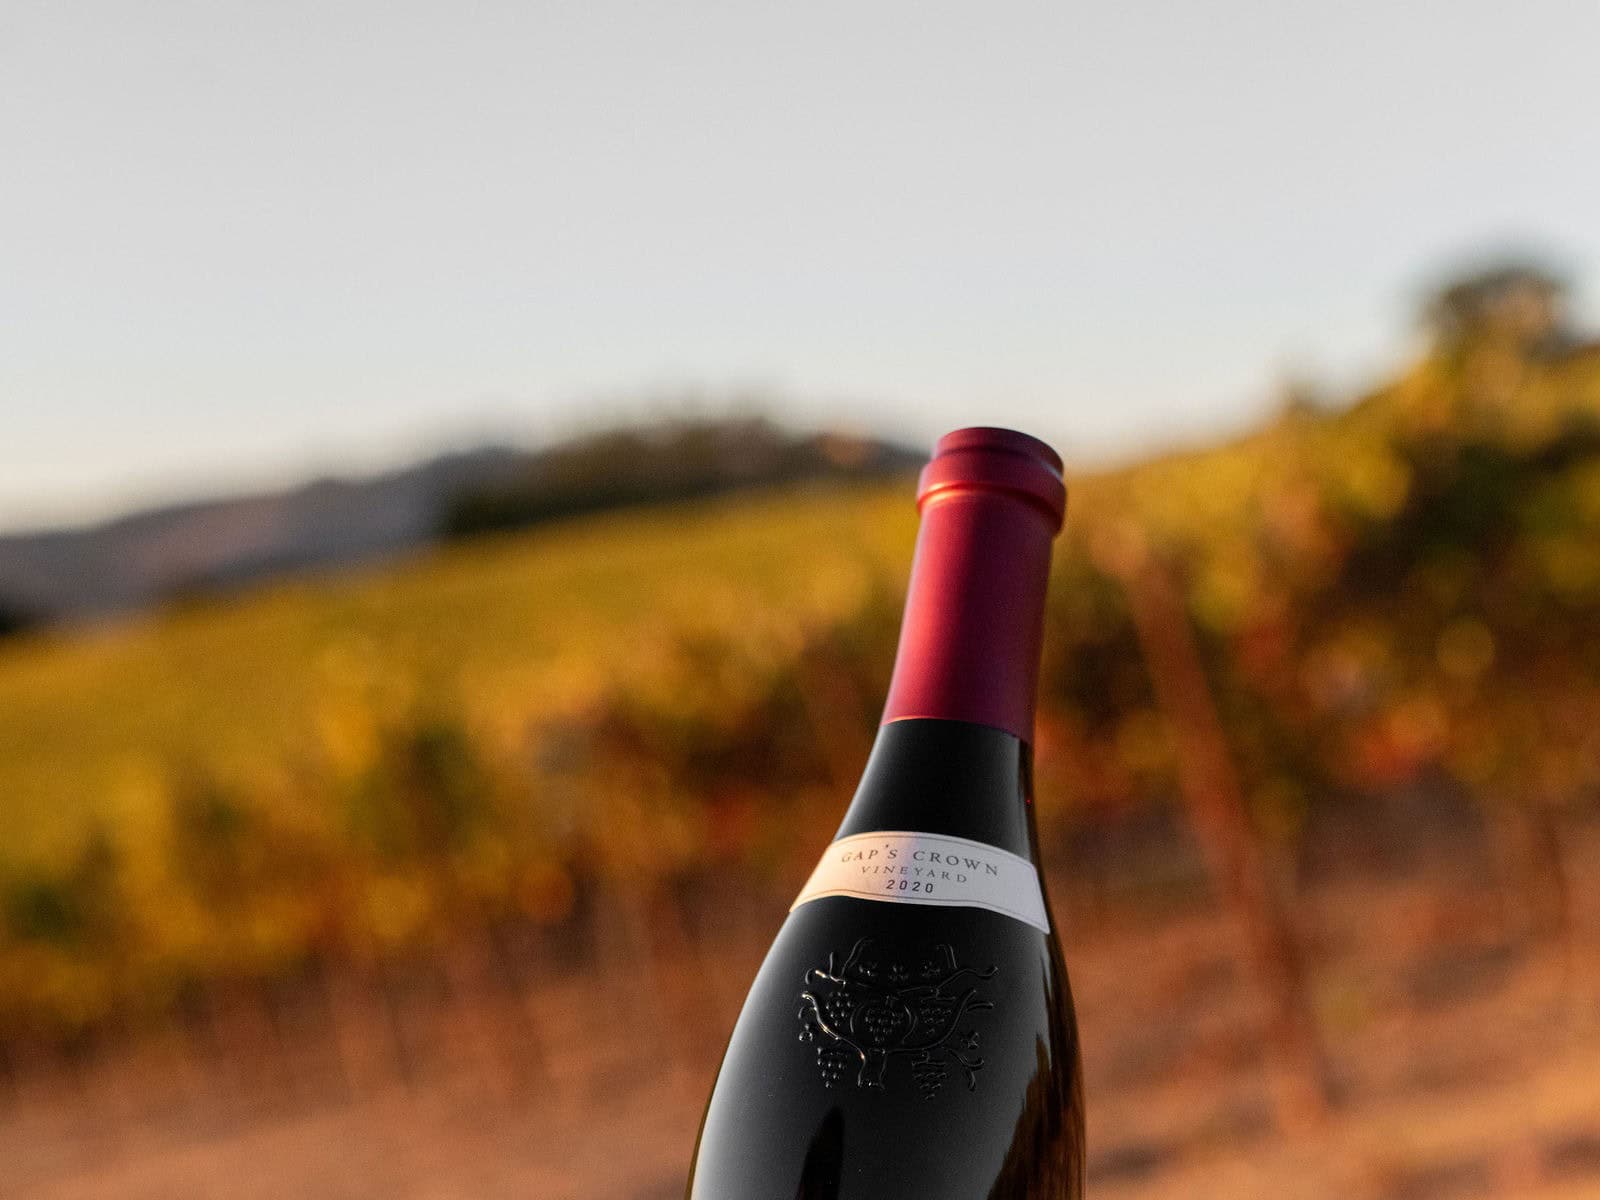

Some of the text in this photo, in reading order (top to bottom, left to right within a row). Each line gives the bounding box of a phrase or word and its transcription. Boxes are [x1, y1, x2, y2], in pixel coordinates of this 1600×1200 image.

[913, 850, 999, 876] CROWN
[861, 866, 967, 883] VINEYARD
[886, 879, 934, 893] 2020
